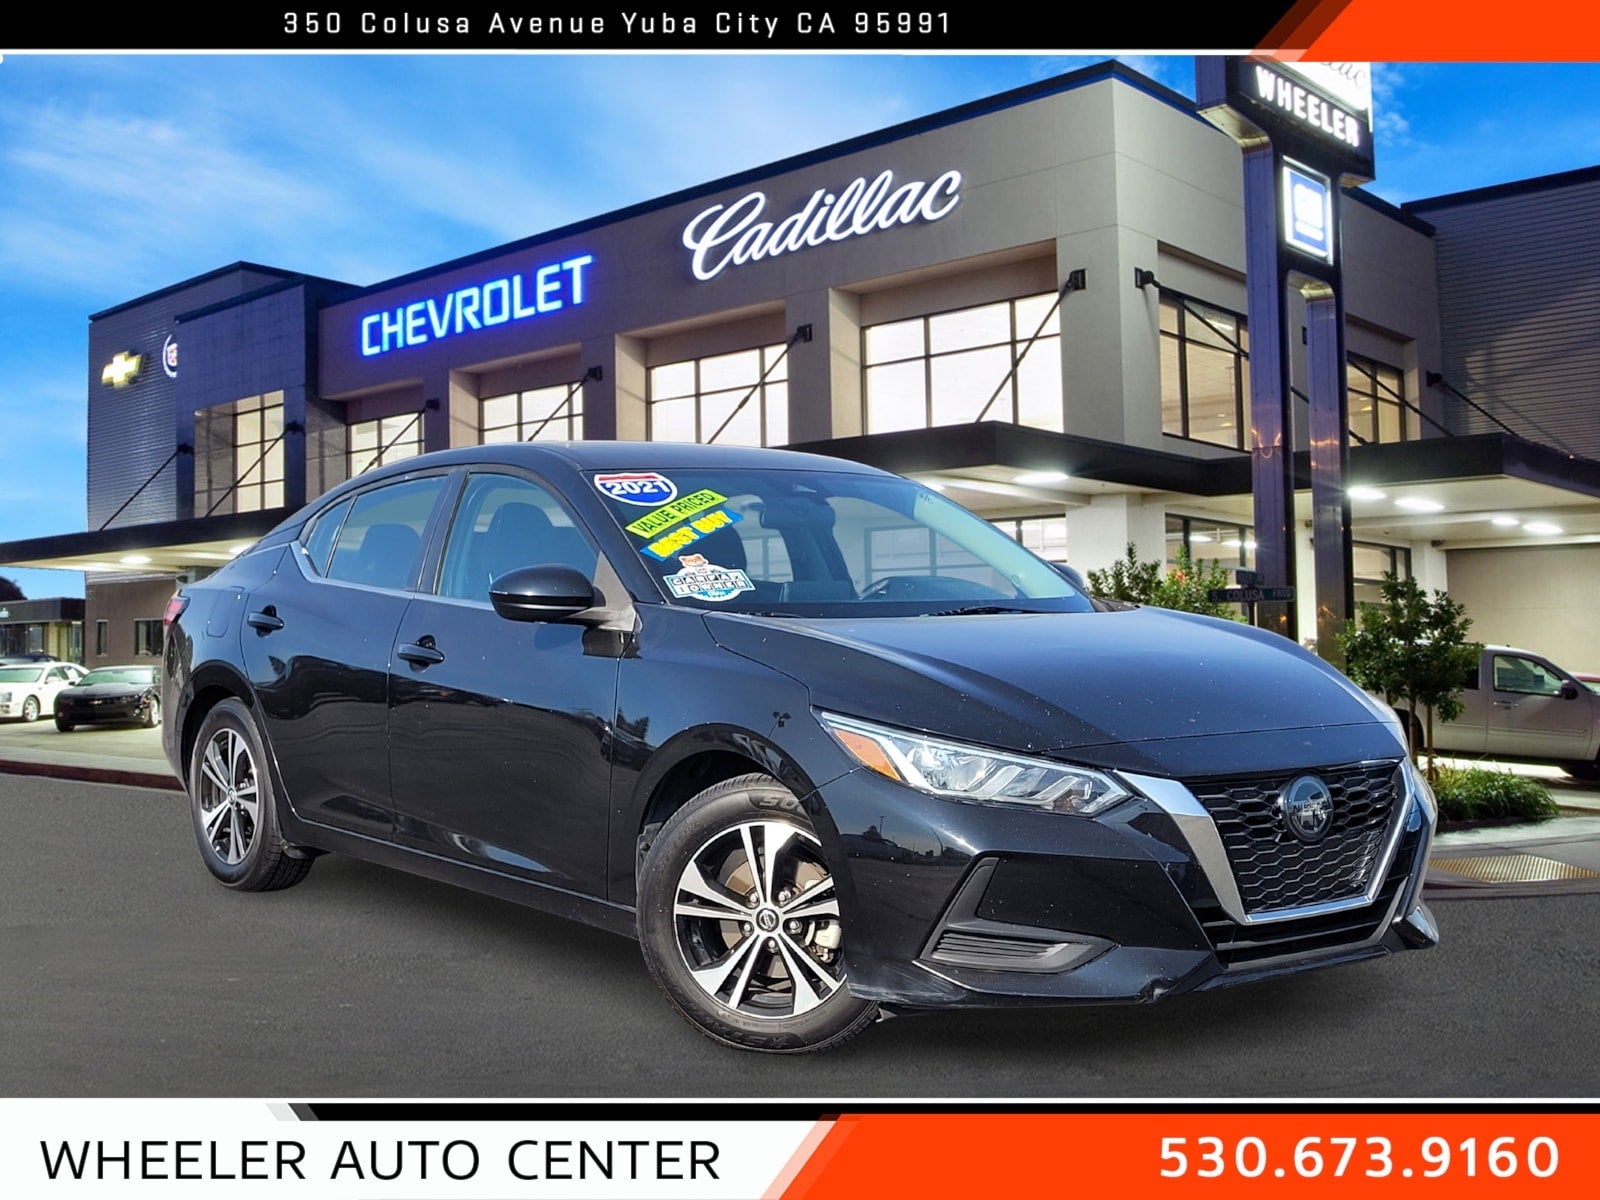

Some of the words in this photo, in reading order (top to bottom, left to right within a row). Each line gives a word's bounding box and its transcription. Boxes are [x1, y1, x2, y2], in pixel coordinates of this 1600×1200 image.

[1255, 65, 1360, 147] WHEELER
[682, 169, 962, 281] Cadillac
[361, 255, 595, 356] CHEVROLET
[605, 480, 671, 496] 2021
[632, 504, 676, 535] VALUE
[670, 491, 717, 515] PRICED
[648, 526, 700, 558] BEST
[691, 510, 734, 534] BUY
[672, 571, 744, 587] CARFAX
[688, 580, 747, 593] OWNER
[1226, 588, 1265, 601] COLUSA
